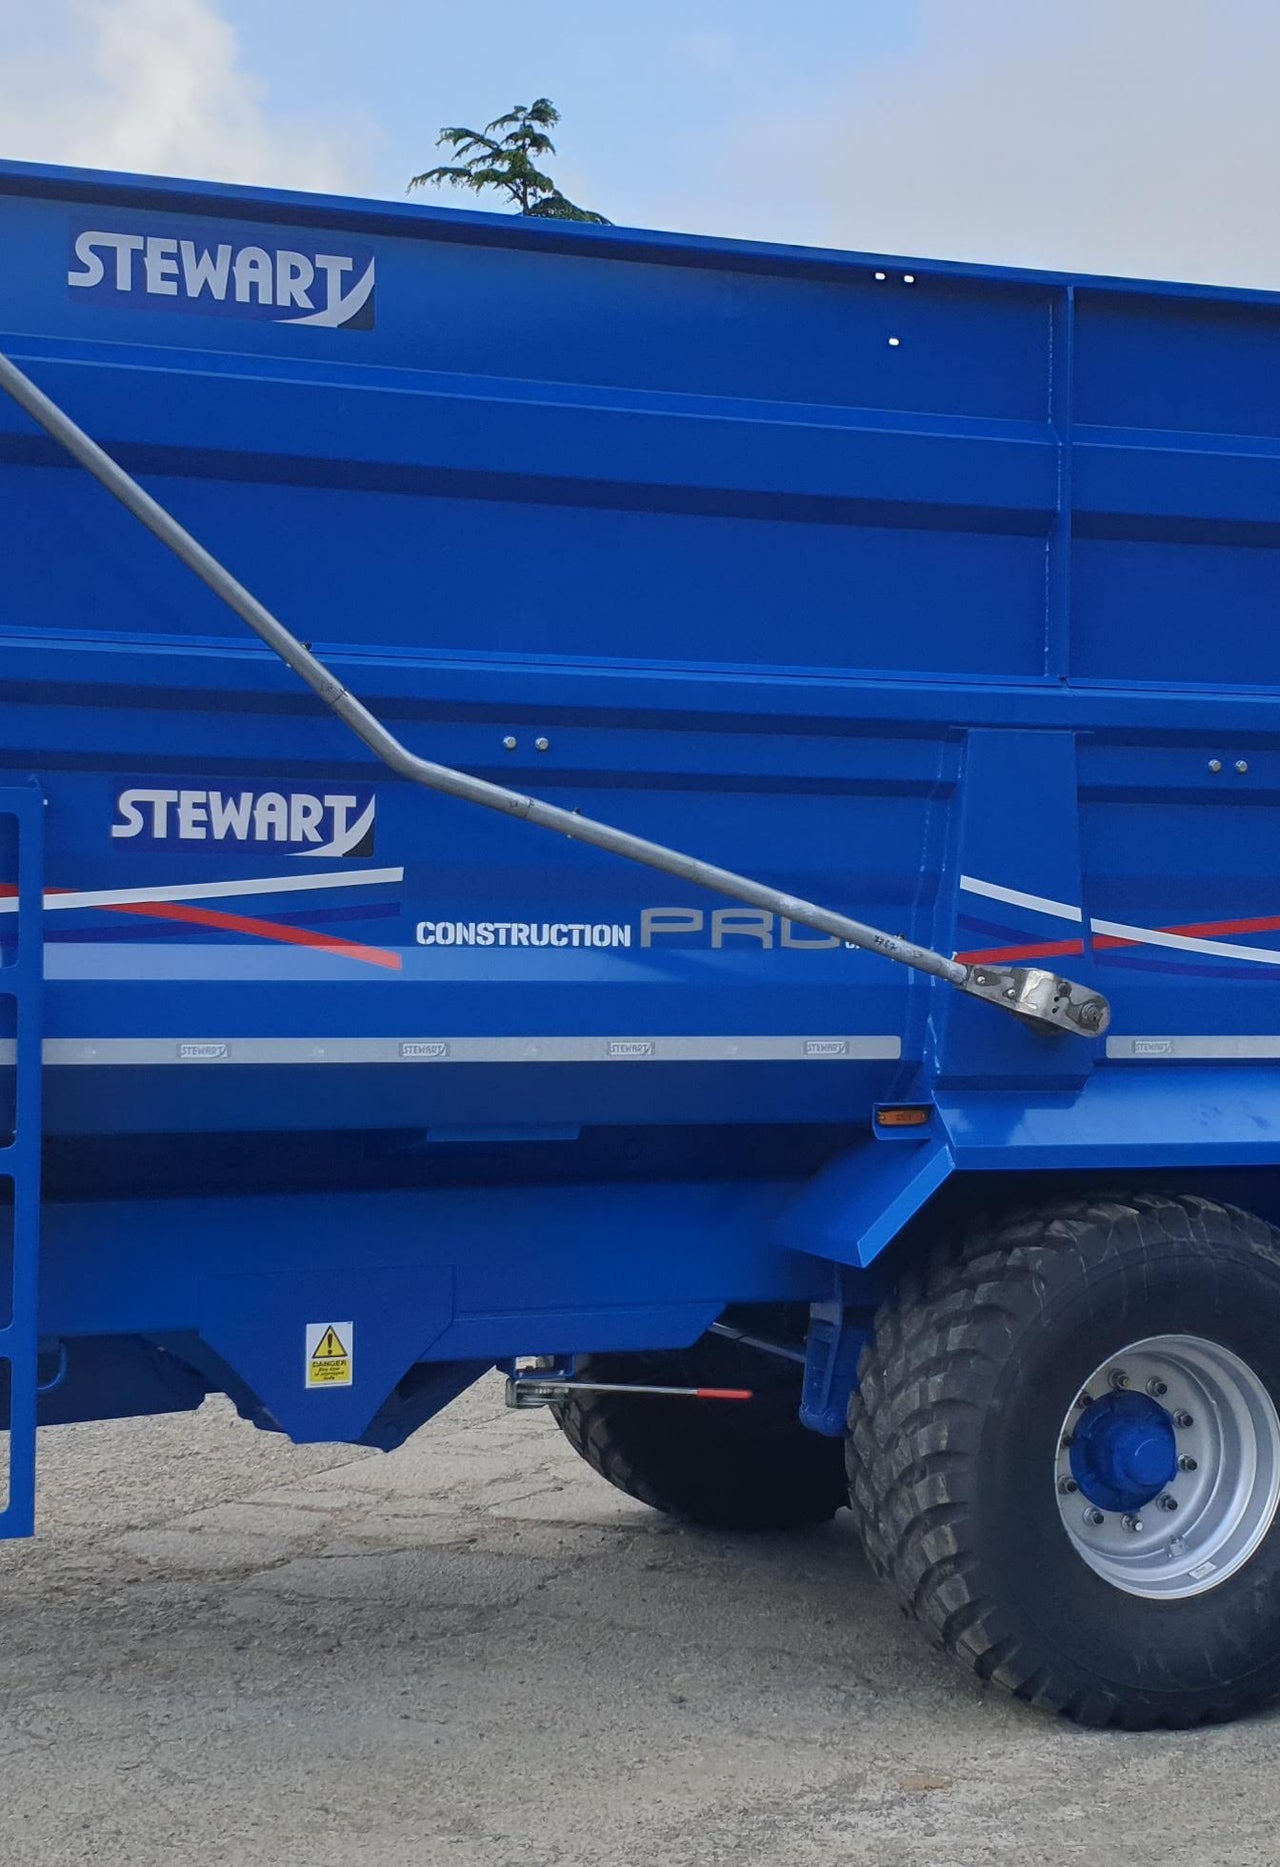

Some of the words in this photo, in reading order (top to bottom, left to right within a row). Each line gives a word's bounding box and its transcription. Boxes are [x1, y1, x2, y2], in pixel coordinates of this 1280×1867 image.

[67, 230, 375, 328] STEWART
[111, 788, 375, 857] STEWART
[416, 921, 631, 947] CONSTRUCTION
